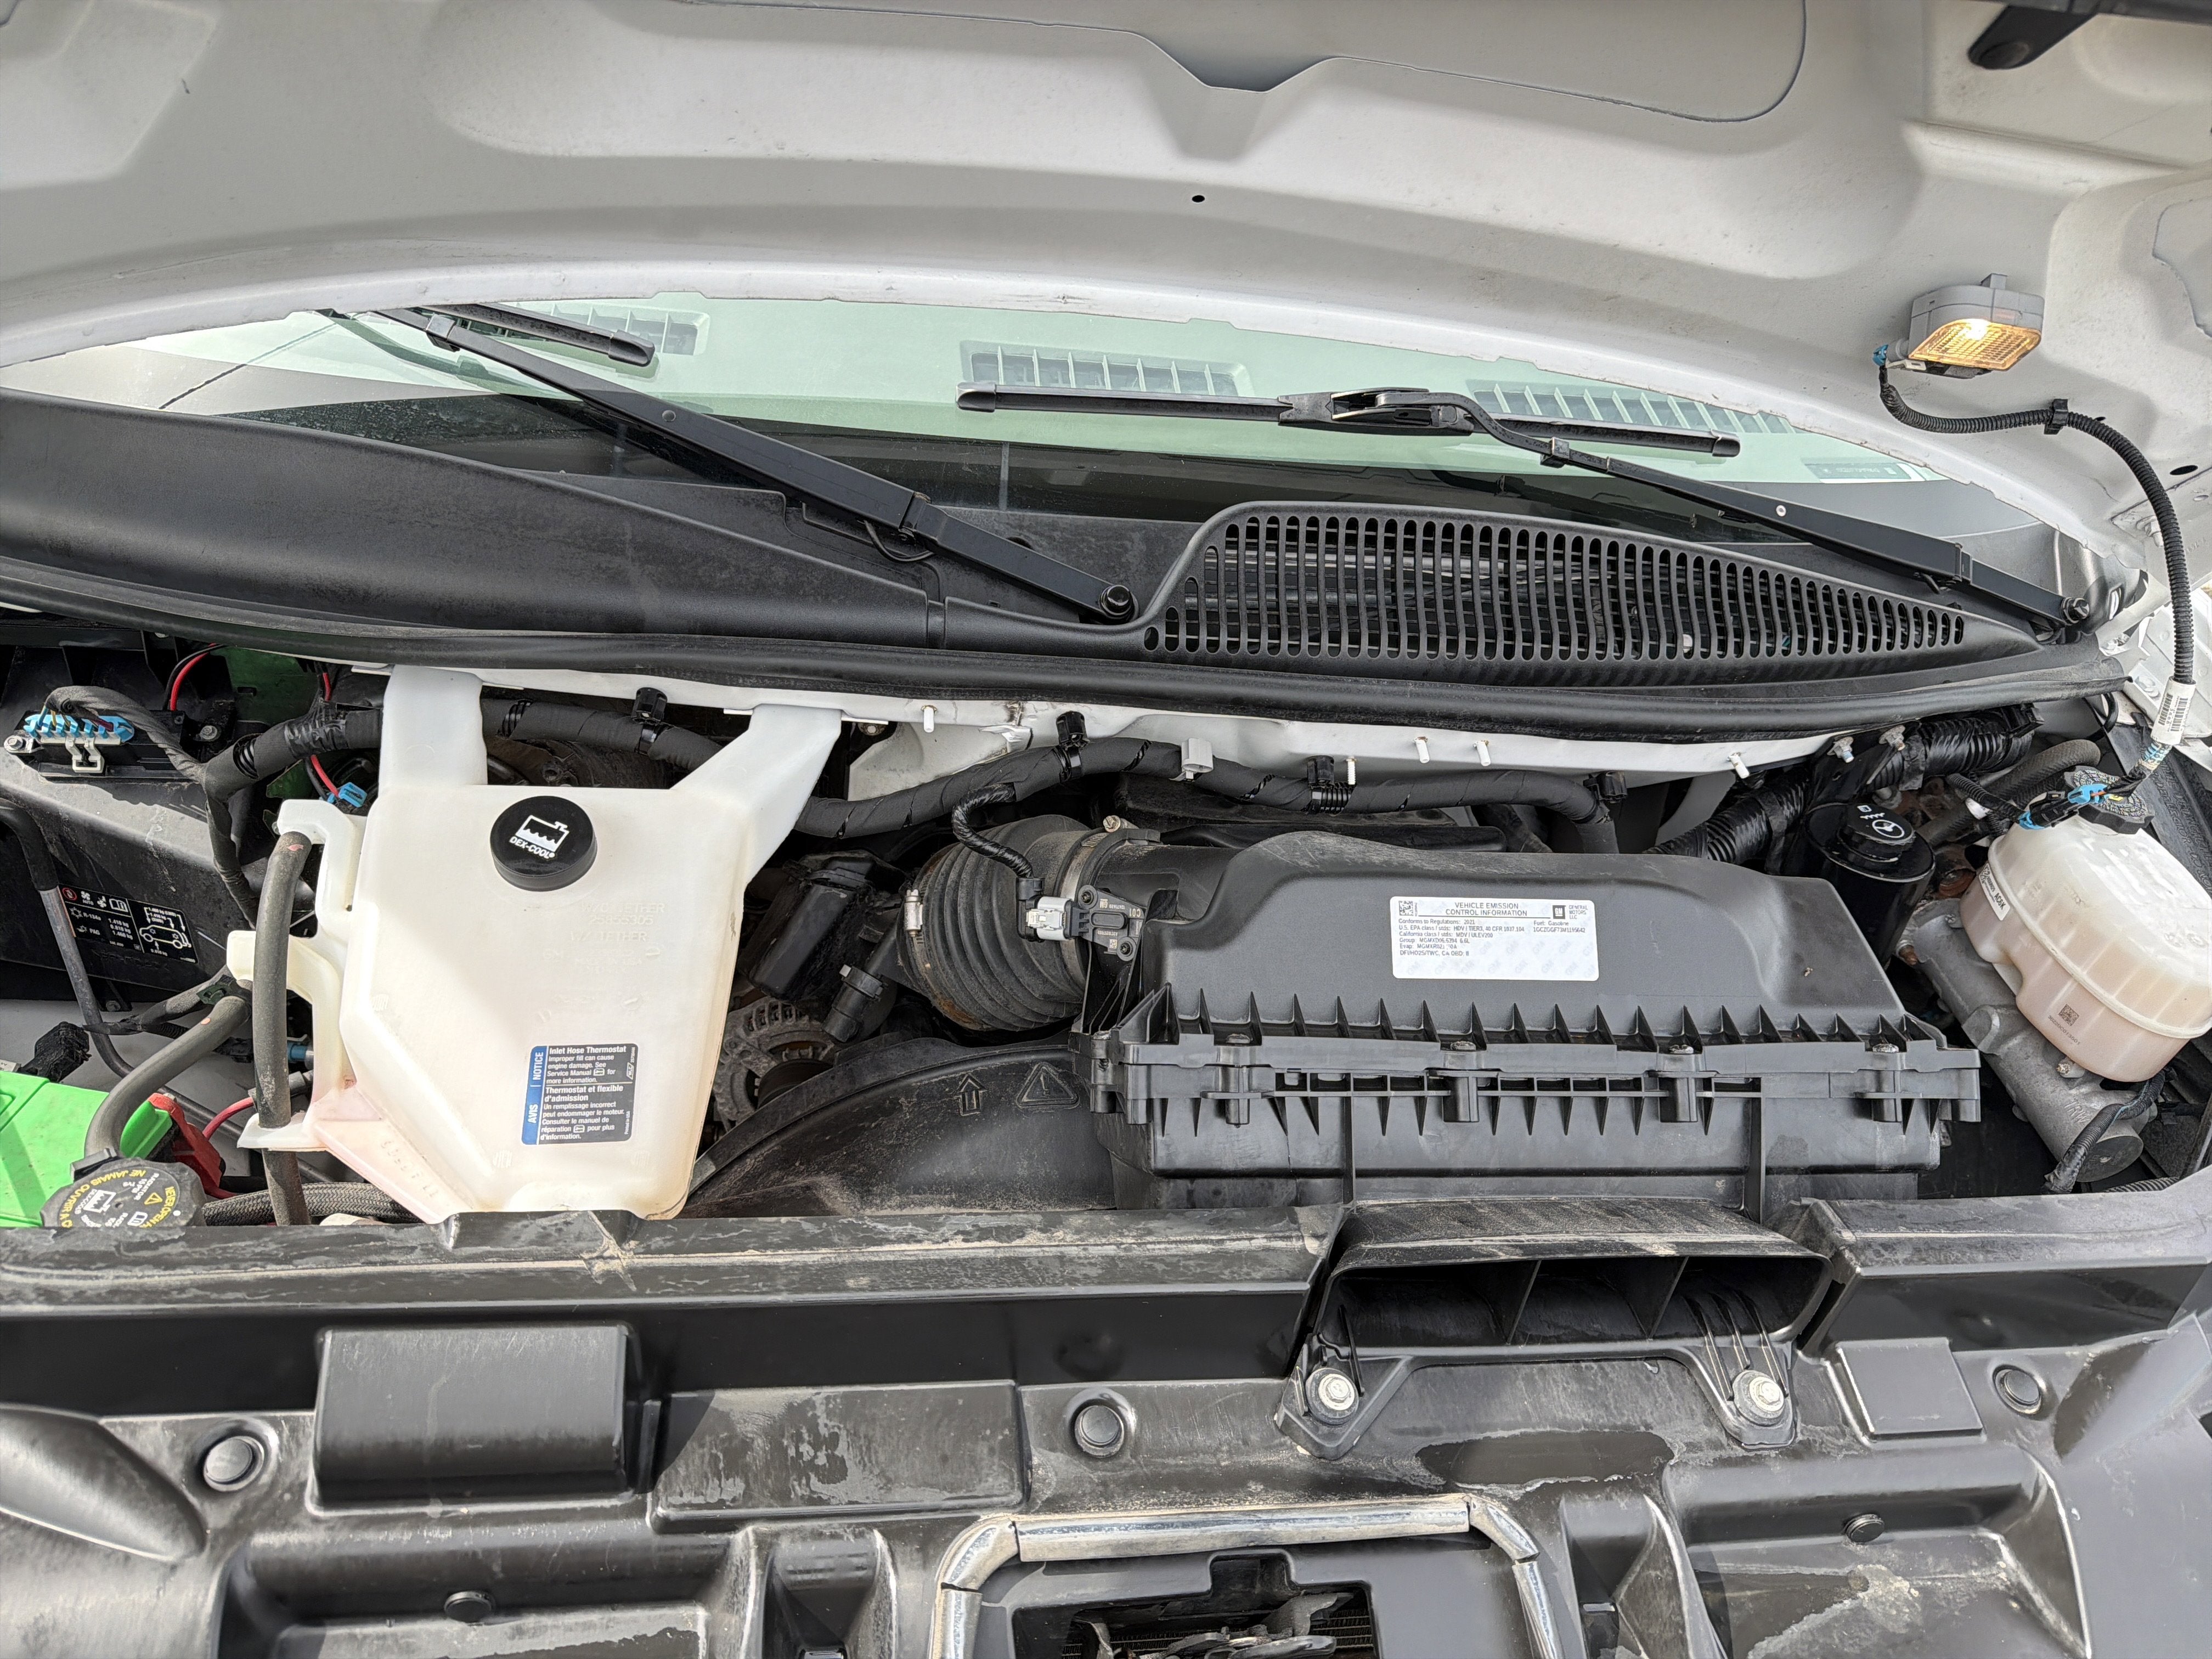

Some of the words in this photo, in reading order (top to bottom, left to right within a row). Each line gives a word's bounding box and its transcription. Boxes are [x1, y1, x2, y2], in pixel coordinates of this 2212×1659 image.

[1994, 893, 2006, 910] AC6K
[83, 912, 101, 921] R-134a
[586, 1046, 627, 1054] Thermostat
[532, 1052, 544, 1080] NOTICE
[597, 1084, 624, 1092] flexible
[544, 1094, 589, 1102] d'admission
[528, 1104, 539, 1124] AVIS
[2064, 1099, 2091, 1124] TRW
[541, 1125, 572, 1134] réparation
[91, 1170, 128, 1186] JAMAIS
[133, 1173, 160, 1201] RADIATOR
[62, 1184, 90, 1212] OUVRIR
[163, 1186, 176, 1206] NEVER
[149, 1207, 171, 1224] OPEN
